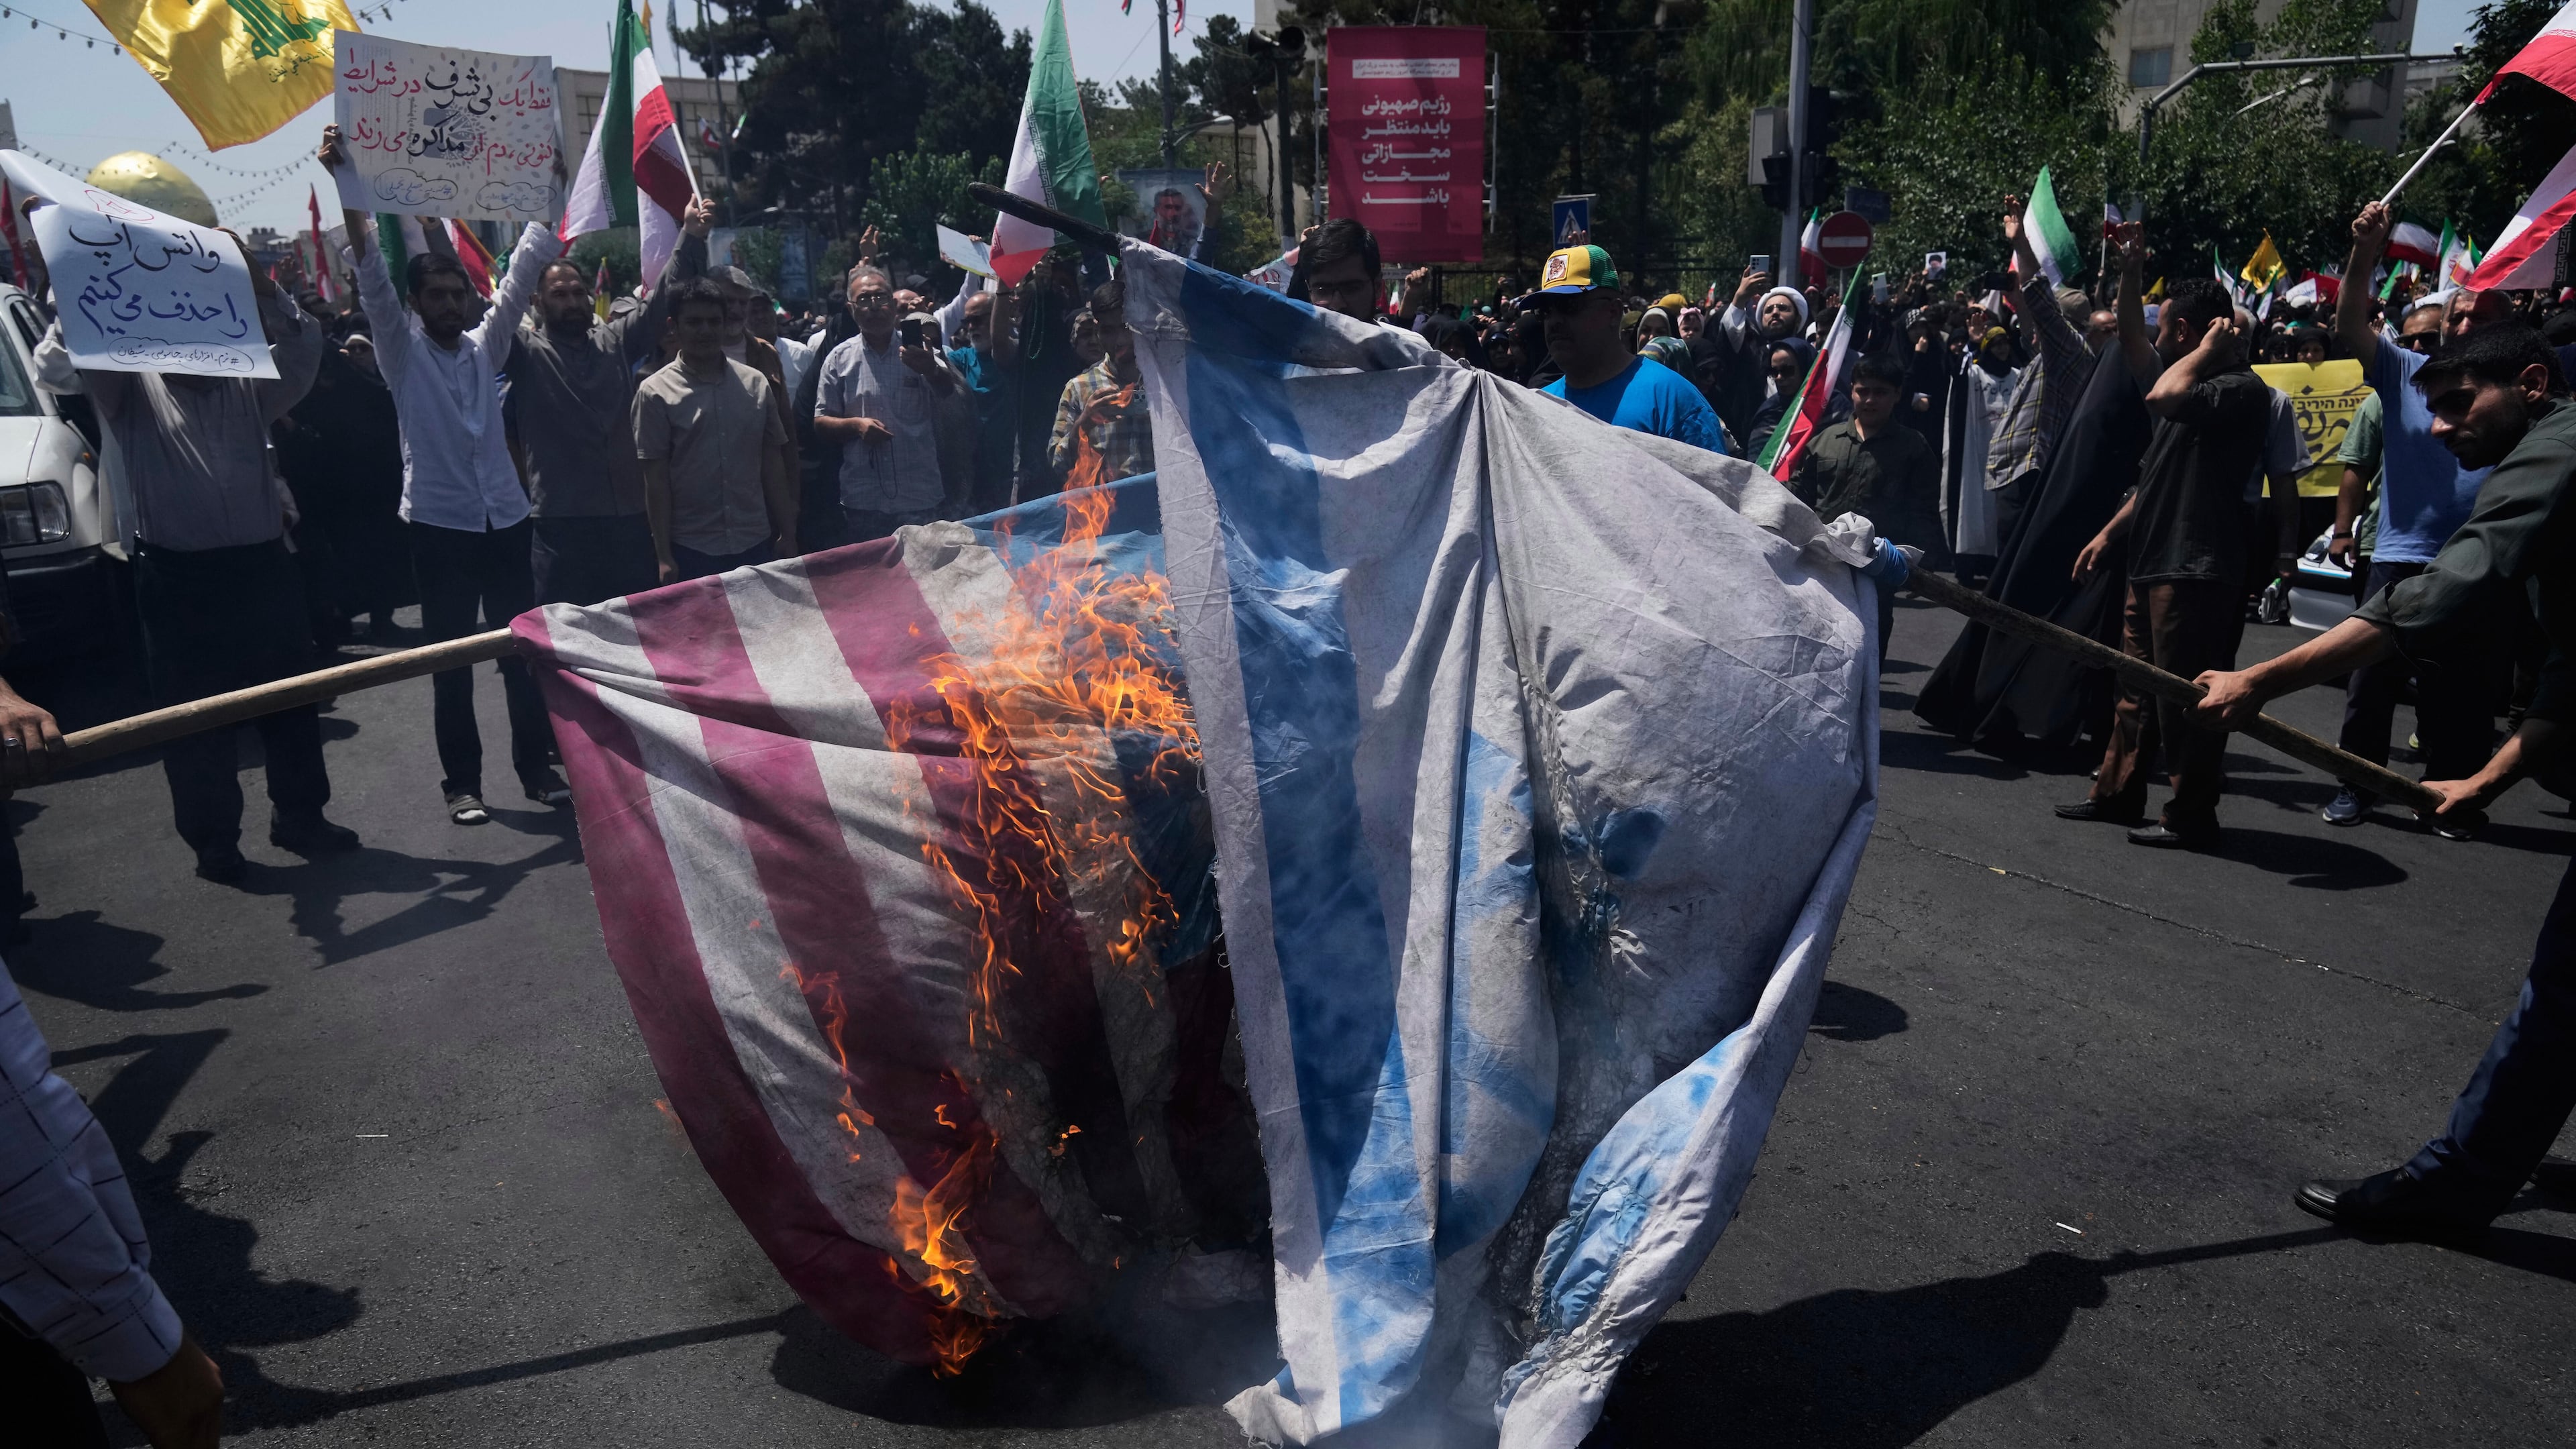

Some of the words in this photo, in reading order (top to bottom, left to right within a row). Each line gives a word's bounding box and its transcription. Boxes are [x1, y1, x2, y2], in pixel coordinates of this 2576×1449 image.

[343, 48, 397, 93] شرایط
[390, 78, 421, 97] در
[498, 65, 537, 117] یک
[529, 80, 551, 109] فقط
[1362, 94, 1419, 115] صهیونی
[1419, 95, 1450, 115] رژیم
[406, 111, 465, 157] مذاکره
[1361, 117, 1421, 139] منتظر
[1421, 118, 1450, 139] باید
[461, 133, 484, 160] از
[1362, 143, 1450, 164] مجازاتی
[487, 142, 506, 176] دم
[1362, 166, 1450, 182] سخت
[1361, 188, 1450, 208] باشد
[134, 229, 221, 272] واتس
[148, 290, 222, 323] حذف
[217, 292, 248, 338] را
[2338, 396, 2366, 409] ינה
